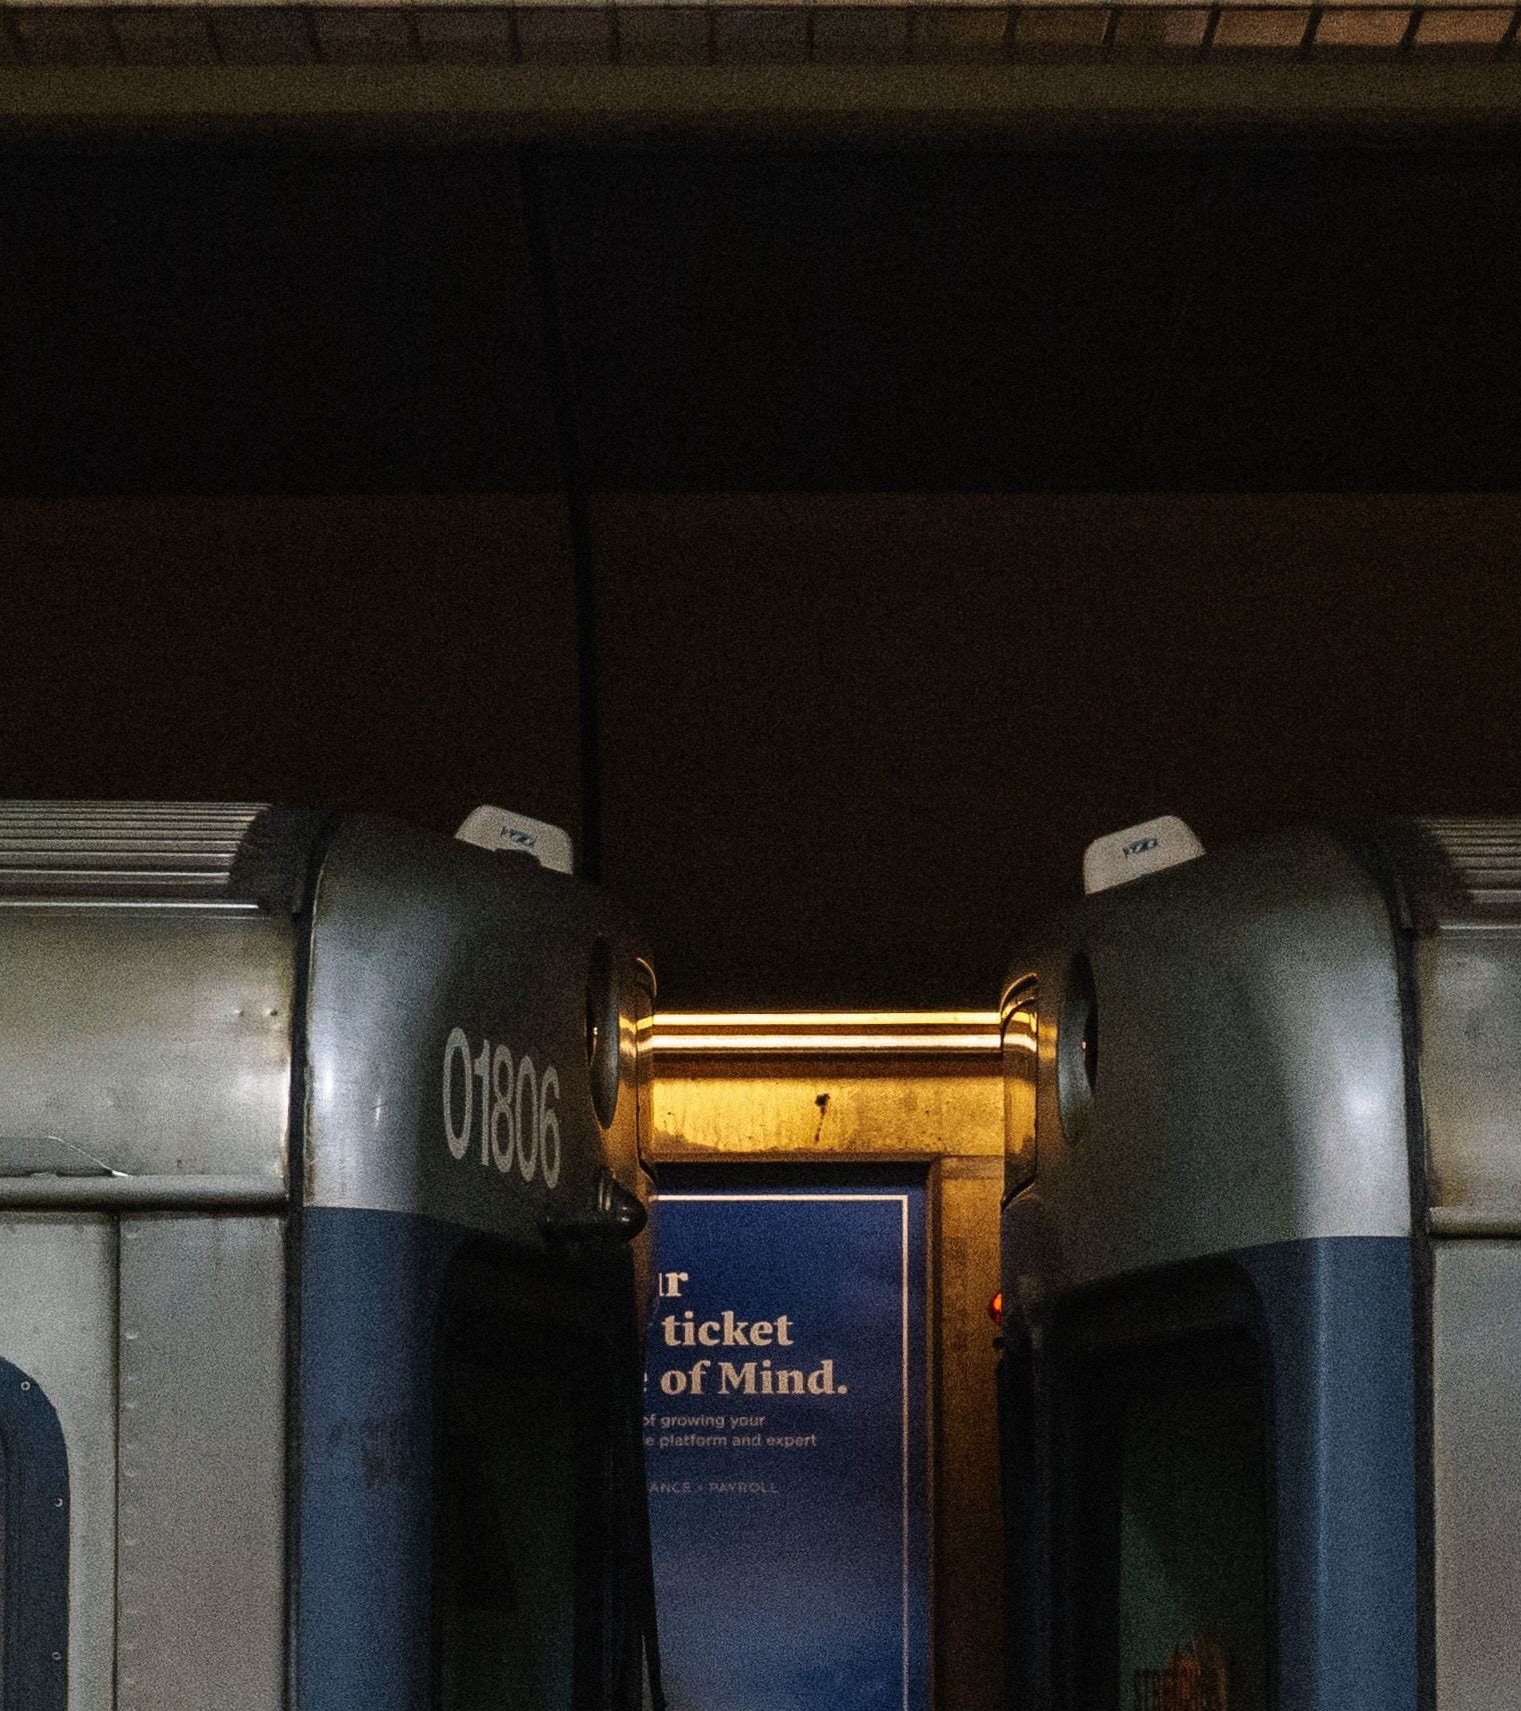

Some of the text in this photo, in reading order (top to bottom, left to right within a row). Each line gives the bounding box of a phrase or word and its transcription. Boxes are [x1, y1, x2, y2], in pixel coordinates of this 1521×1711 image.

[442, 1026, 561, 1188] 01806
[661, 1310, 794, 1347] ticket
[660, 1359, 711, 1396] of
[717, 1359, 848, 1396] Mind.
[660, 1415, 726, 1431] growing
[729, 1415, 767, 1431] your
[658, 1433, 728, 1449] platform
[731, 1433, 763, 1447] and
[765, 1433, 818, 1449] expert
[707, 1480, 780, 1495] PAYROLL
